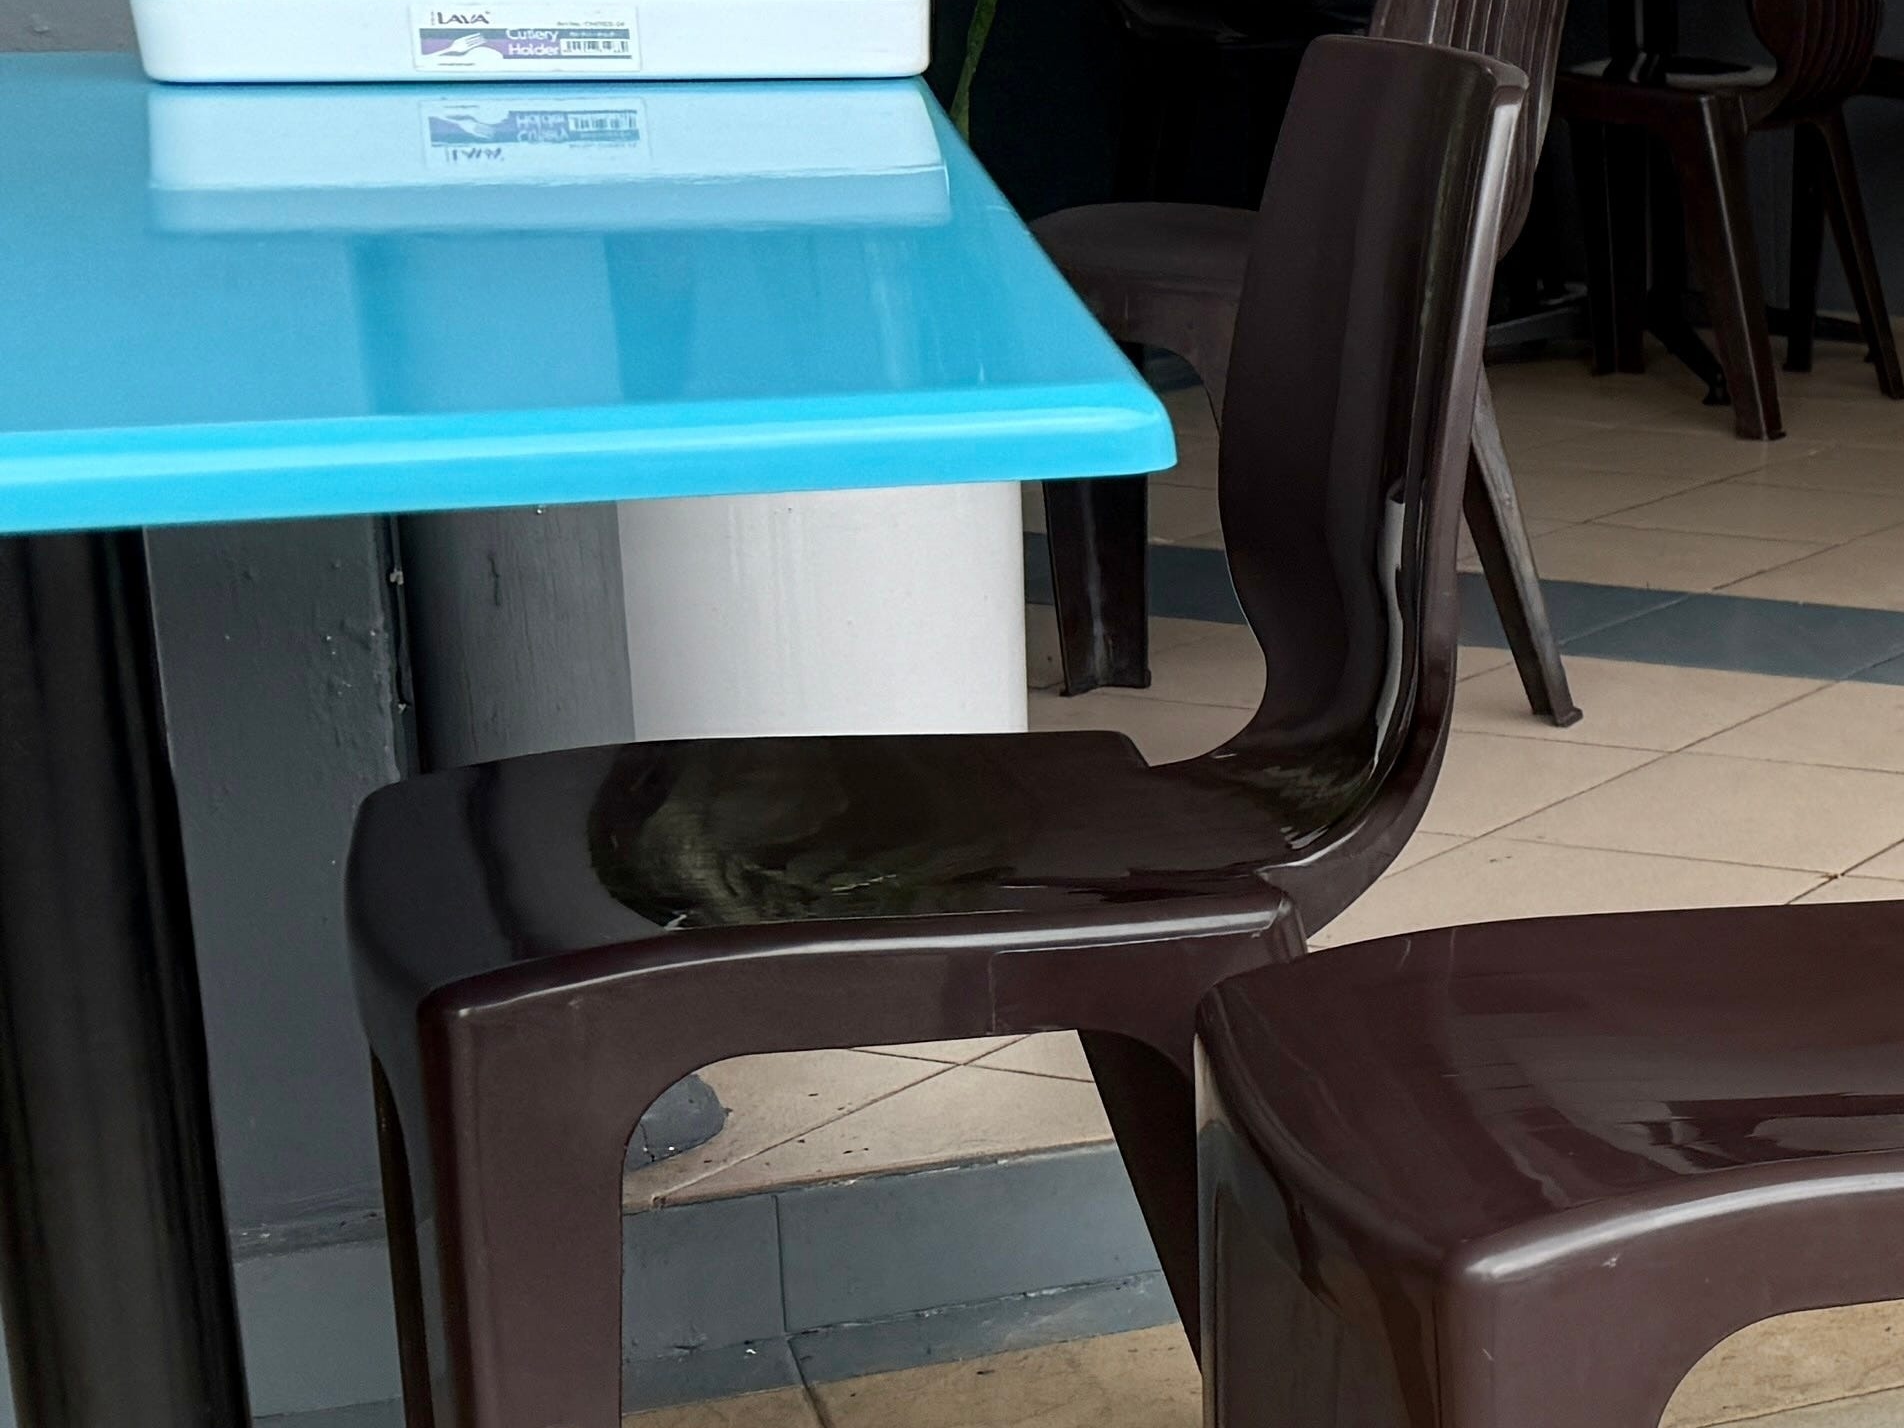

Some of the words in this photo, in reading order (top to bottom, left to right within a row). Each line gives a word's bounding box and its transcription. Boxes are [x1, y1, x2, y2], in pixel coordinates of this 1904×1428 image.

[437, 11, 490, 24] LAVA
[505, 28, 560, 42] Cutlery
[508, 42, 560, 56] Holder
